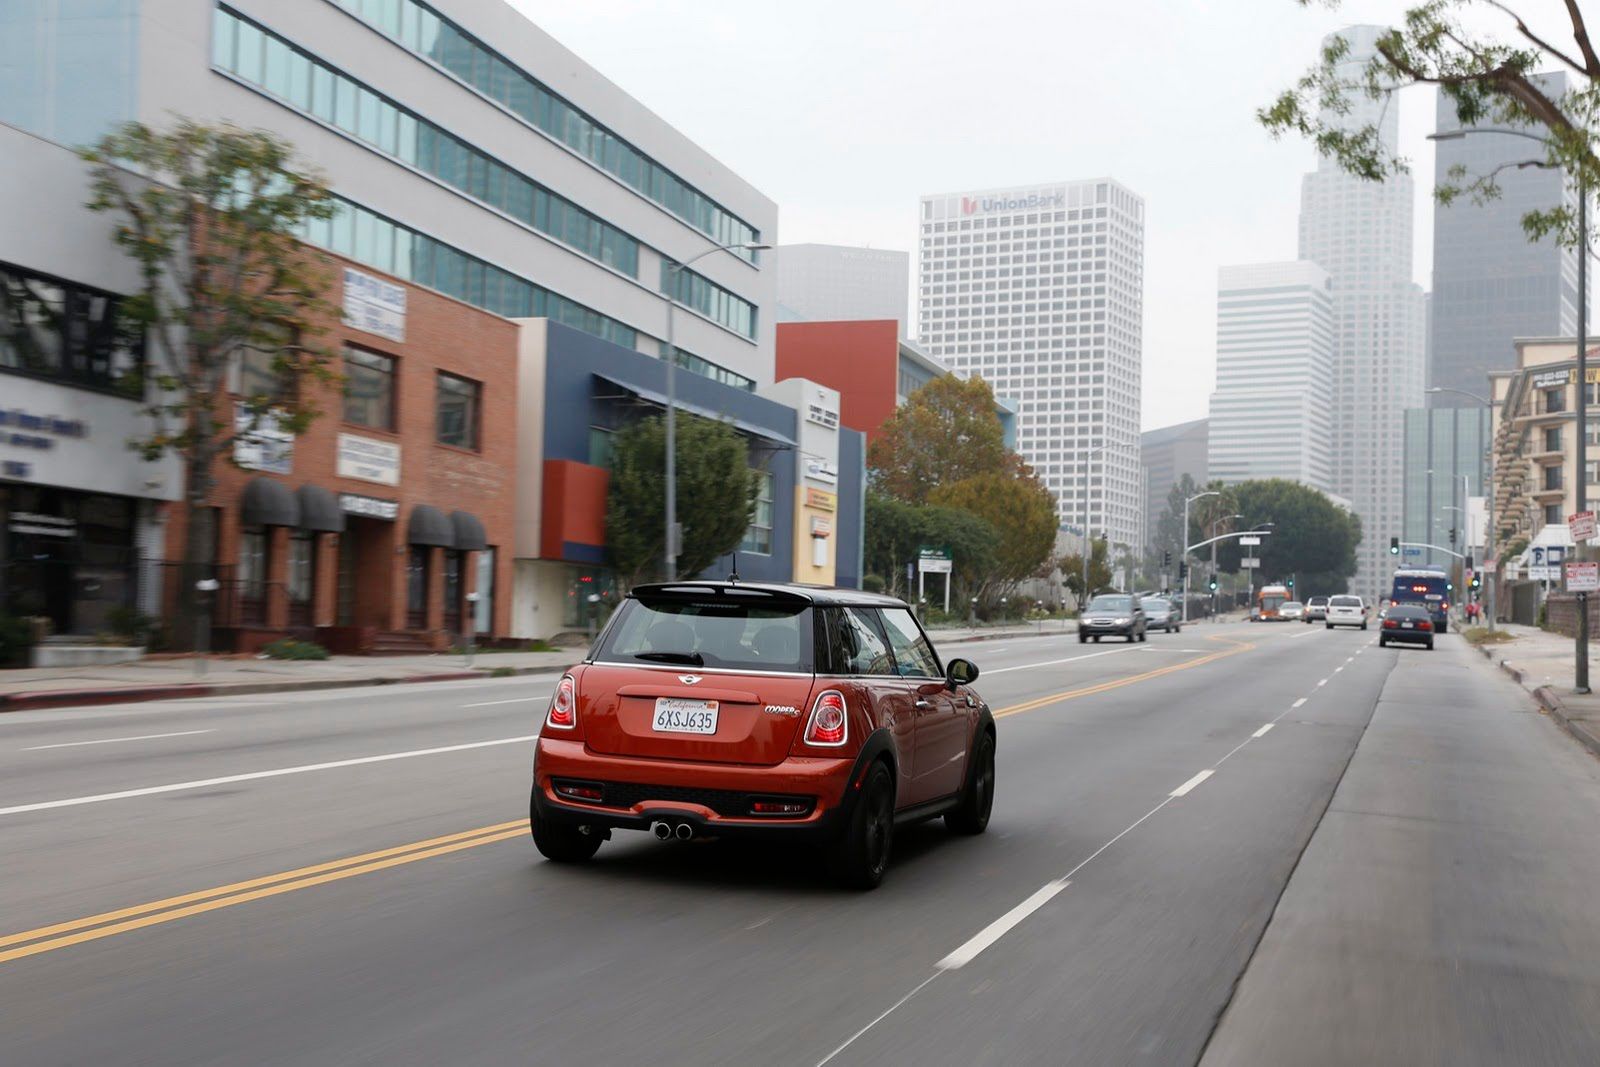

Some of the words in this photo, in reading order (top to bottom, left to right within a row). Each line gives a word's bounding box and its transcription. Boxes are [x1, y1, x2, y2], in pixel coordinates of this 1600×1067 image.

[982, 193, 1063, 211] UnionBank
[669, 701, 704, 710] California
[765, 705, 795, 715] COOPER
[657, 711, 712, 728] 6XSJ635
